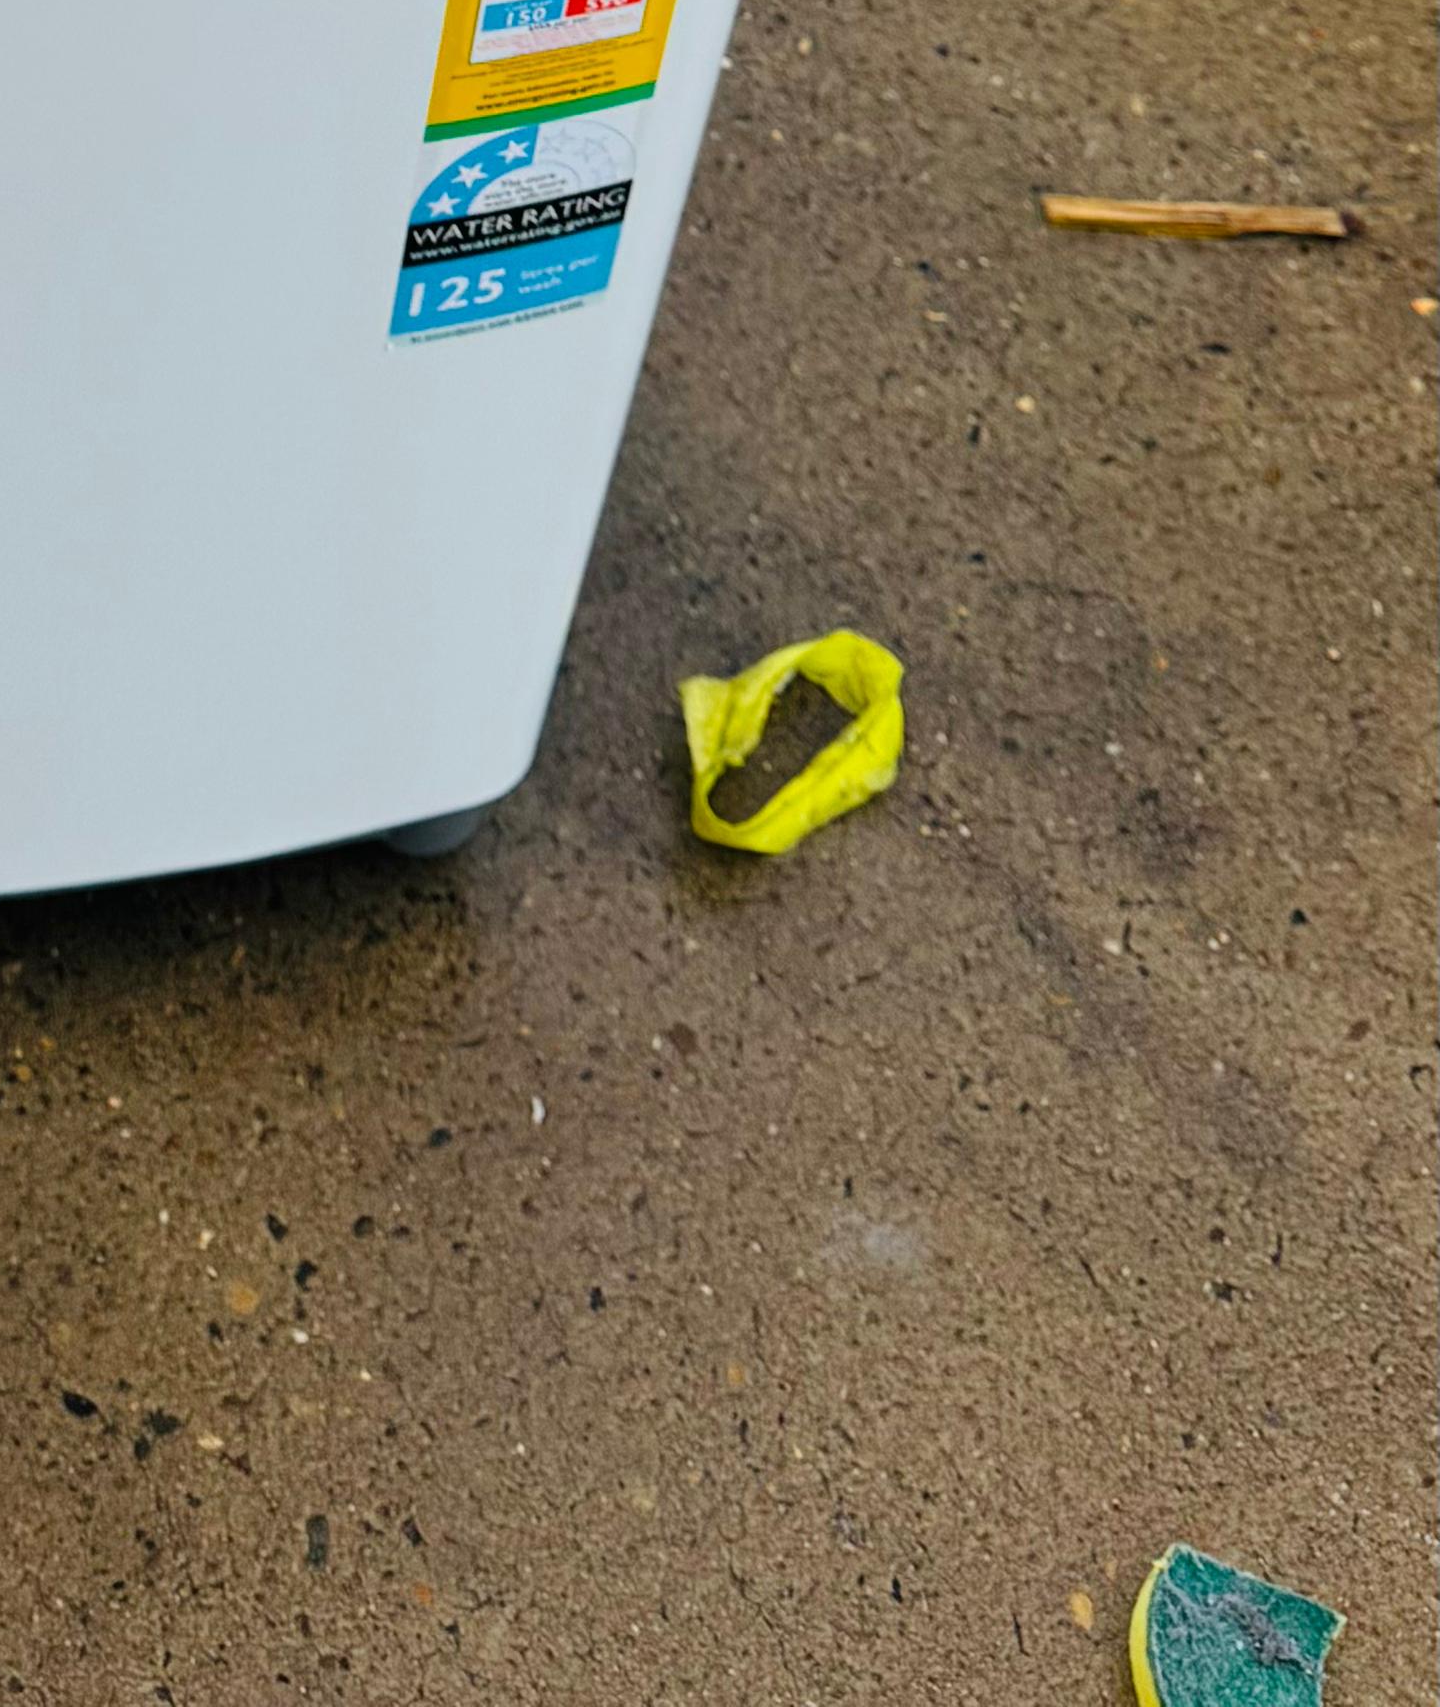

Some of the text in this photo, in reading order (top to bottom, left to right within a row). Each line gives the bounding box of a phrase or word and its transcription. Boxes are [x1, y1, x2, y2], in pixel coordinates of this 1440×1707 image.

[506, 7, 547, 28] 150
[412, 188, 627, 246] WATER RATING
[408, 267, 506, 318] 125
